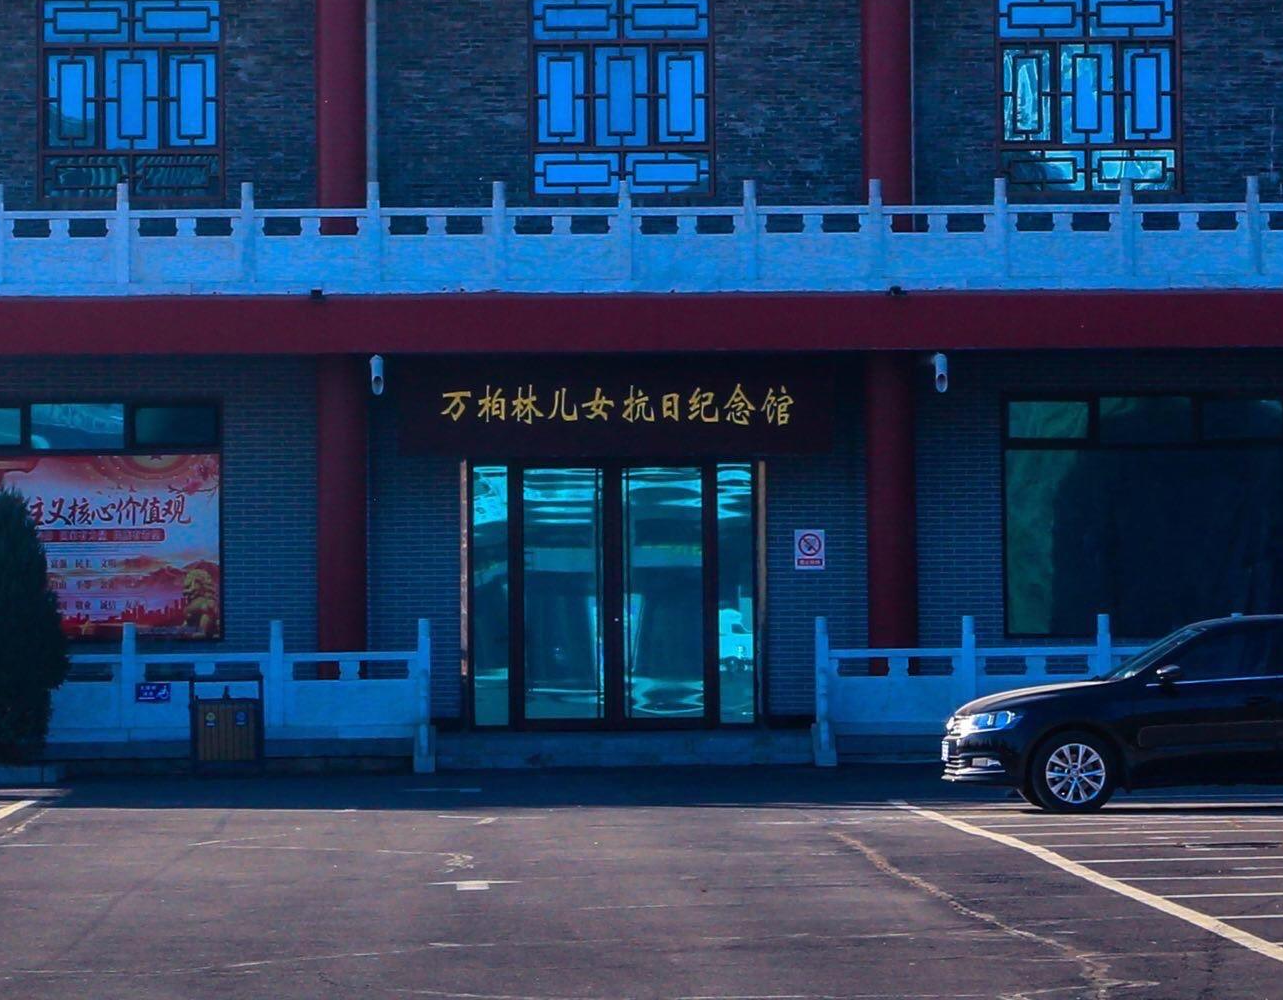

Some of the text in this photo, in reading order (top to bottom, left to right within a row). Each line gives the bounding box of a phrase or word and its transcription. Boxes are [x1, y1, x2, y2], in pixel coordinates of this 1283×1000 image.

[441, 383, 795, 427] 万柏林儿女抗日纪念馆
[28, 493, 192, 527] 主义核心价值观
